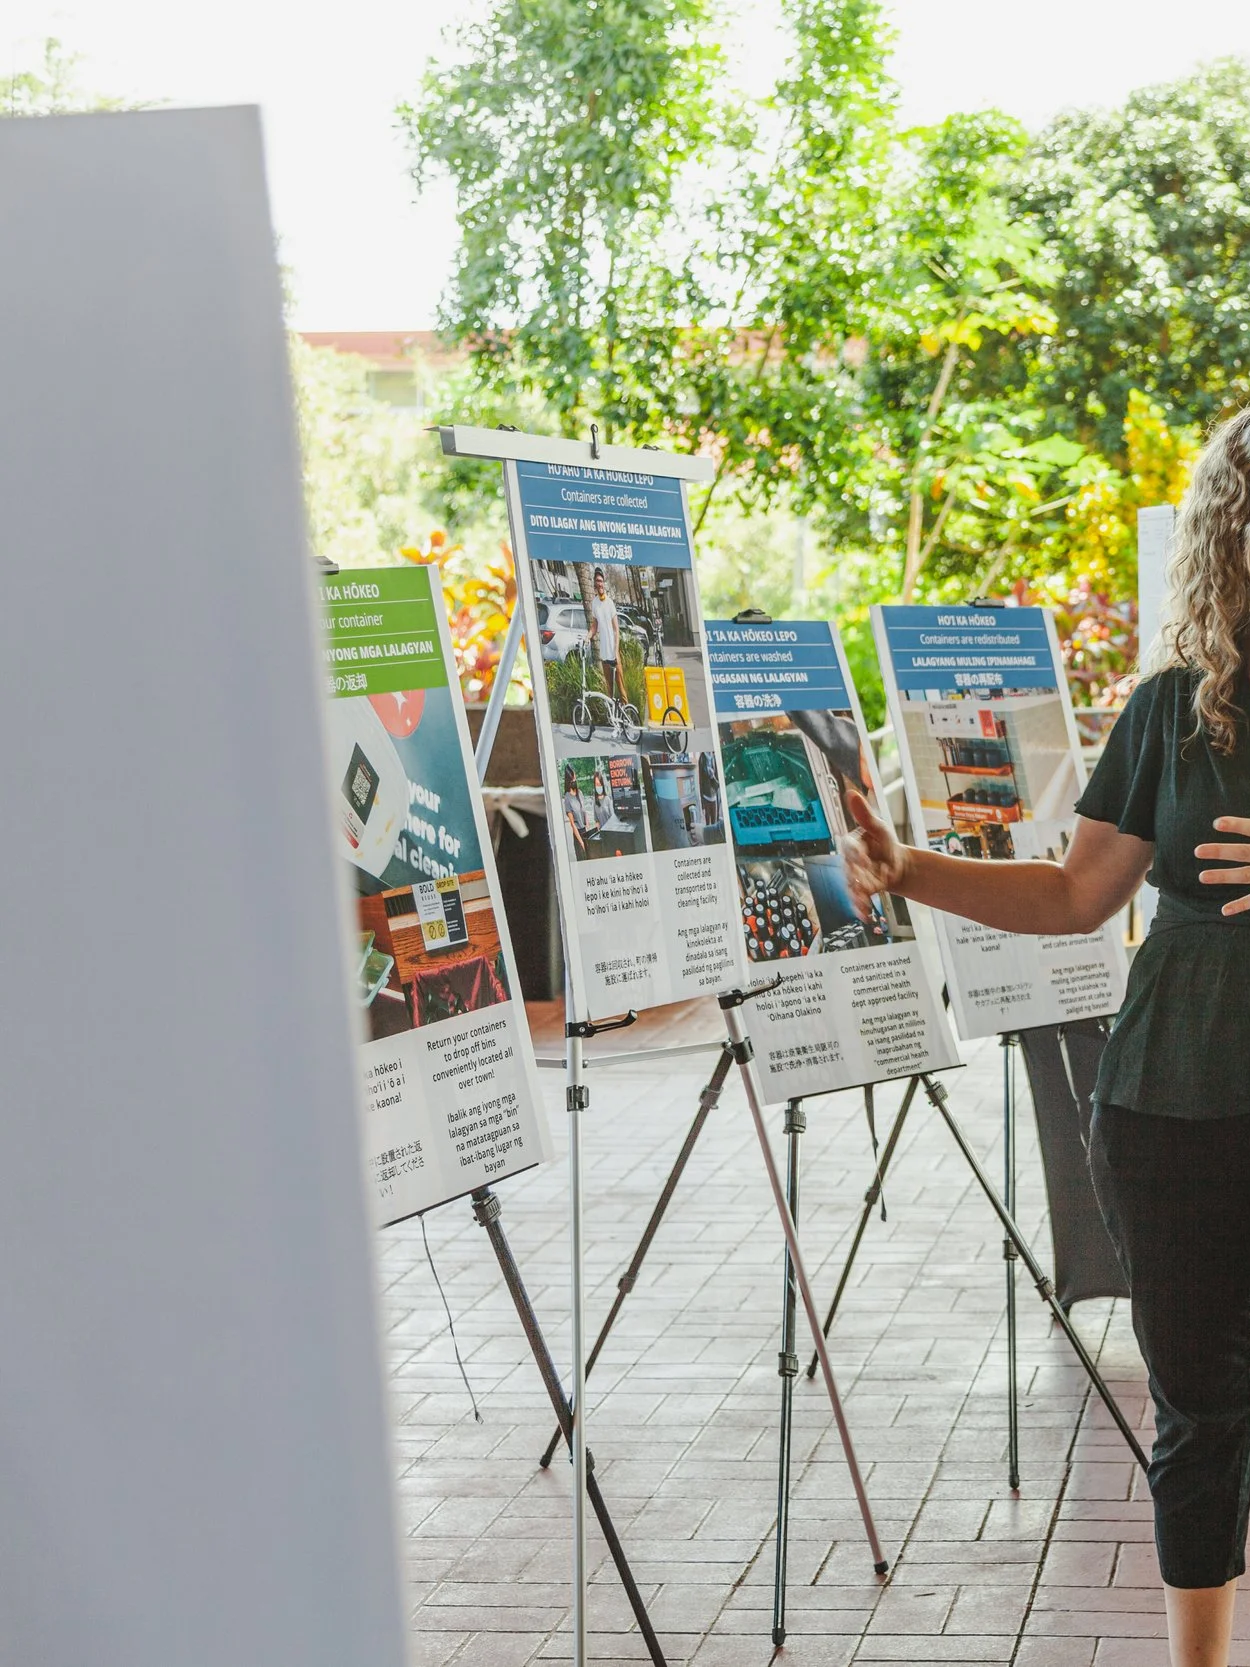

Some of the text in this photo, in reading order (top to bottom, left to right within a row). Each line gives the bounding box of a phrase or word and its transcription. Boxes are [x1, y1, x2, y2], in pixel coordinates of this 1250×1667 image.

[634, 475, 654, 486] LEPO
[561, 488, 648, 509] Containers are collected
[530, 515, 682, 539] DITO ILAGAY ANG INYONG MGA LALAGYAN
[592, 542, 633, 561] 容器の返却
[326, 582, 380, 600] KA HŌKEO
[338, 612, 383, 629] container
[956, 616, 969, 626] KA
[727, 631, 741, 642] KA
[742, 628, 774, 642] HŌKEO
[775, 631, 798, 642] LEPO
[920, 633, 1021, 645] Containers are redistributed
[360, 644, 383, 659] MGA
[384, 640, 434, 657] LALAGYAN
[746, 654, 760, 663] are
[760, 650, 793, 663] washed
[912, 656, 956, 667] LALAGYANG
[956, 656, 986, 667] MULING
[750, 673, 764, 684] NG
[764, 672, 809, 683] LALAGYAN
[408, 780, 441, 814] your
[438, 825, 461, 858] for
[674, 857, 711, 868] Containers are
[617, 874, 625, 883] ka
[678, 868, 711, 881] collected and
[419, 883, 434, 894] BOLD
[675, 882, 706, 895] transported
[707, 883, 713, 891] to
[584, 892, 598, 904] lepo
[602, 890, 610, 899] ke
[622, 900, 635, 910] kahi
[635, 898, 650, 908] holoi
[678, 894, 718, 908] cleaning facility
[840, 956, 911, 974] Containers are washed
[814, 970, 823, 978] ka
[852, 975, 865, 984] and
[866, 970, 894, 982] sanitized
[772, 988, 781, 996] ka
[808, 981, 823, 991] kahi
[854, 979, 911, 996] commercial health
[756, 1001, 775, 1011] holoi
[817, 993, 826, 1001] ka
[852, 990, 919, 1009] dept approved facility
[796, 1007, 822, 1018] Olakino
[427, 1020, 506, 1052] Return your containers
[444, 1039, 496, 1062] to drop off bins
[374, 1062, 398, 1077] hōkeo
[432, 1046, 514, 1082] conveniently located all
[396, 1078, 401, 1087] a
[458, 1069, 495, 1090] over town!
[376, 1092, 402, 1110] kaona!
[448, 1093, 516, 1123] Ibalik ang iyong mga
[448, 1122, 478, 1139] lalagyan
[480, 1119, 487, 1128] sa
[488, 1114, 503, 1125] mga
[456, 1122, 520, 1152] na matatagpuan sa
[460, 1136, 523, 1167] ibat-ibang lugar ng
[484, 1159, 506, 1173] bayan
